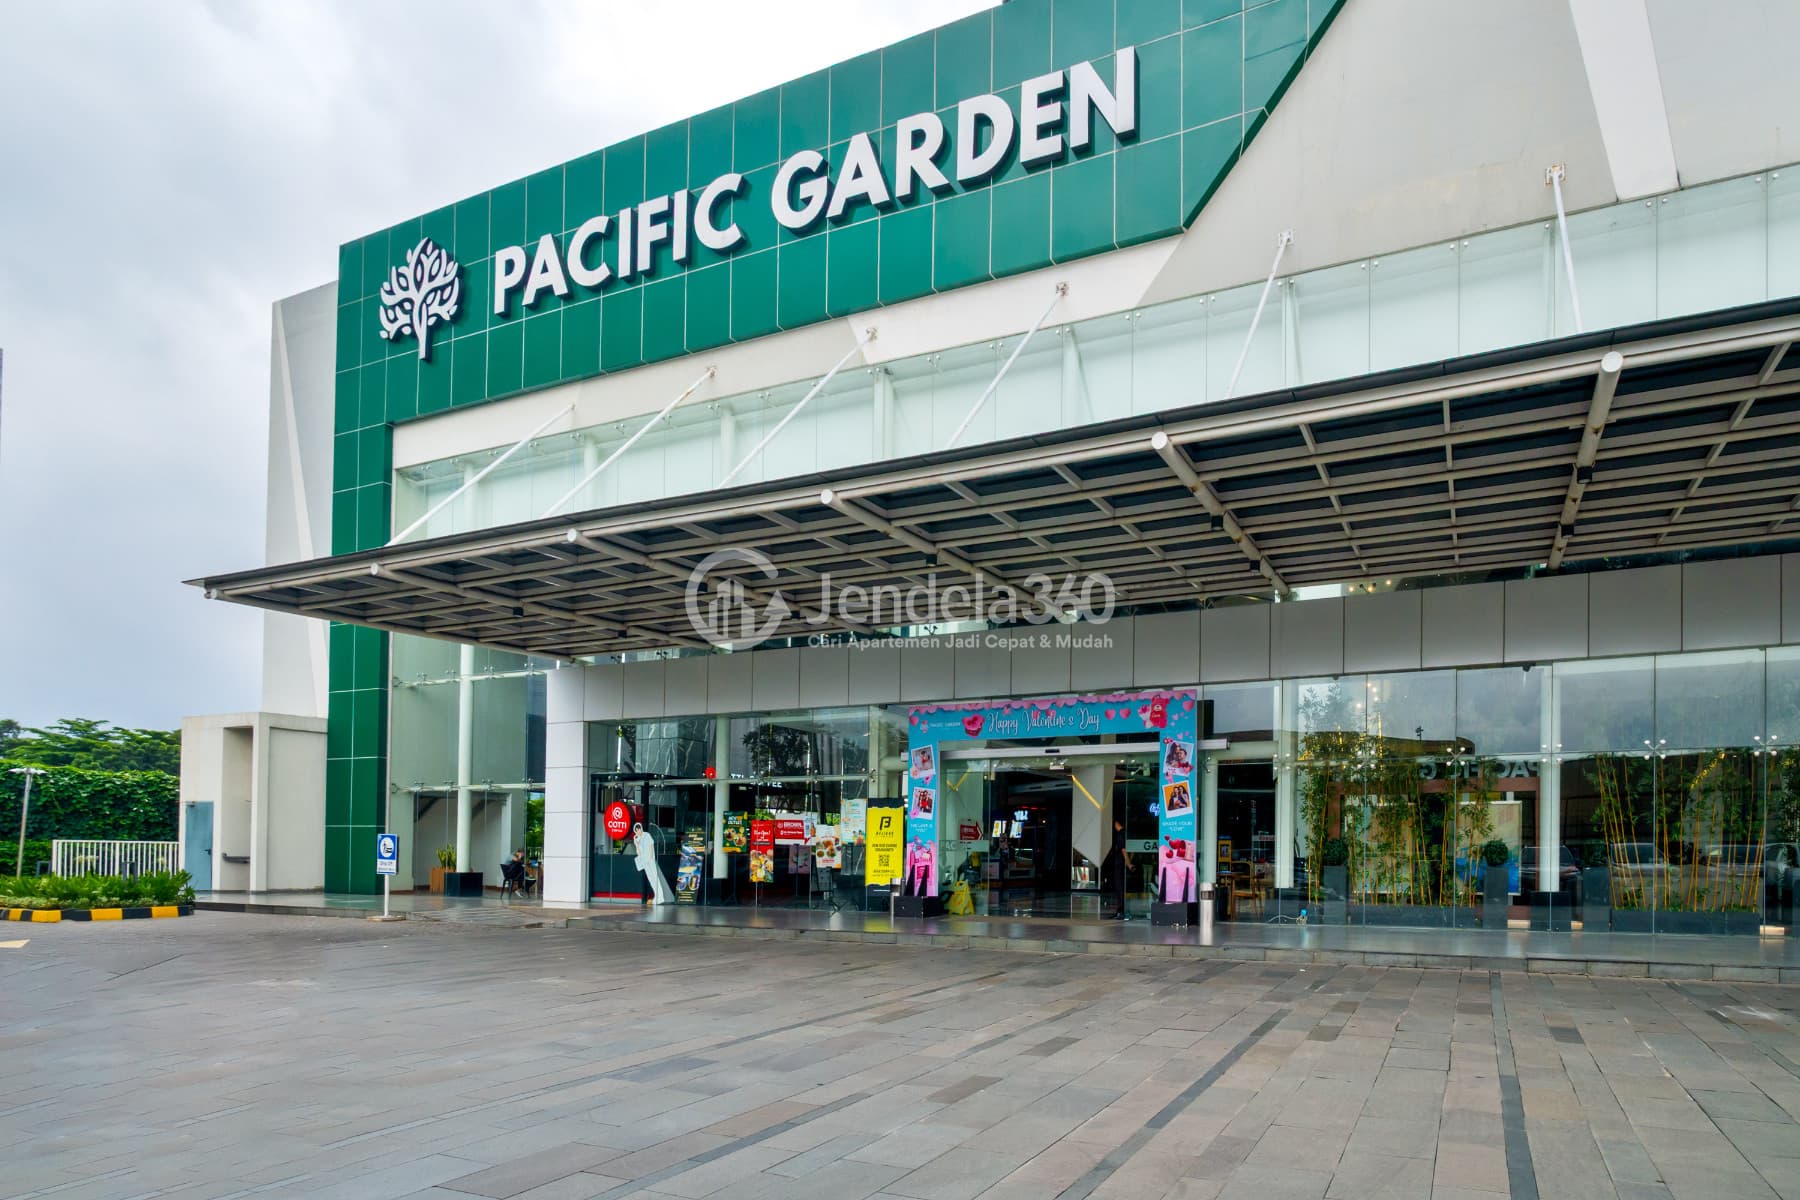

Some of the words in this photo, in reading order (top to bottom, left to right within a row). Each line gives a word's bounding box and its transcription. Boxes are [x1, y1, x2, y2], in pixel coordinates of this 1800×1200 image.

[494, 172, 746, 317] PACIFIC
[771, 46, 1138, 232] GARDEN
[988, 711, 1019, 735] Happy
[1076, 706, 1100, 732] Day
[607, 821, 627, 830] COTTI
